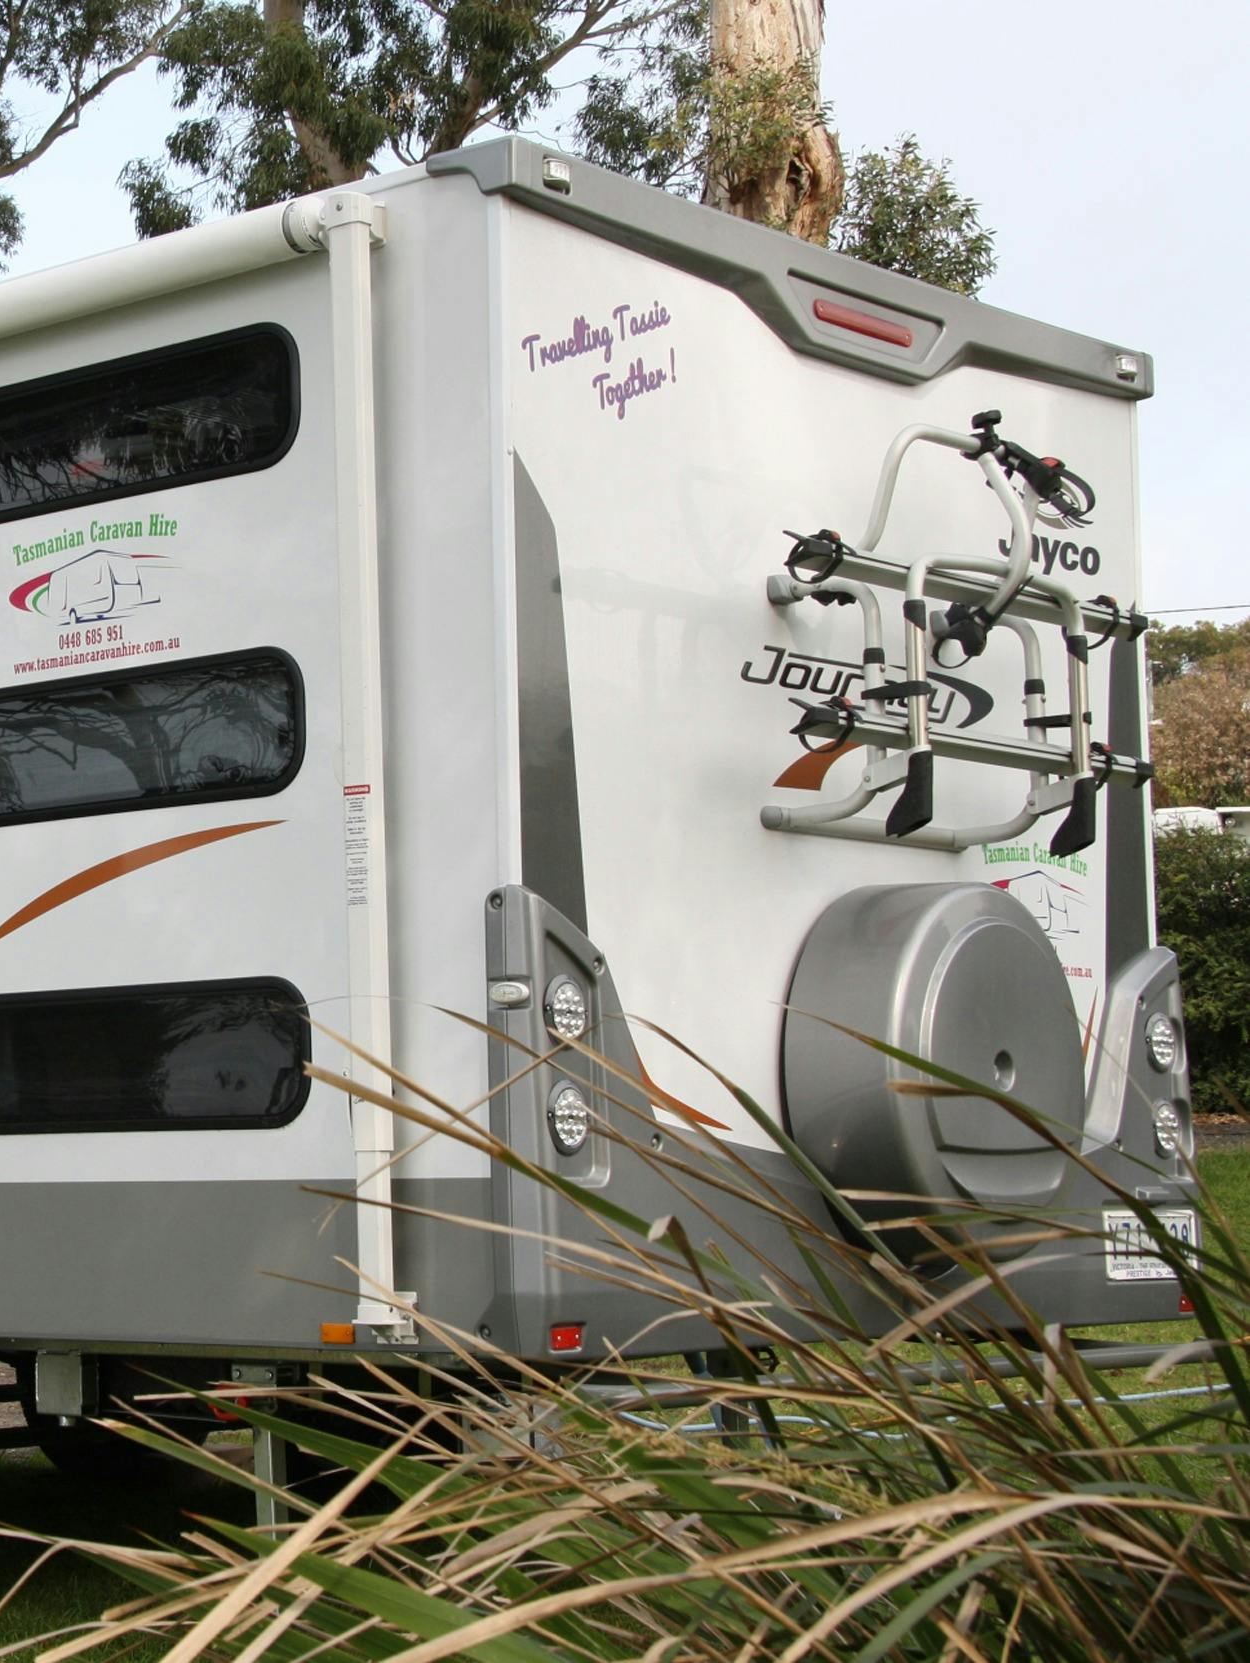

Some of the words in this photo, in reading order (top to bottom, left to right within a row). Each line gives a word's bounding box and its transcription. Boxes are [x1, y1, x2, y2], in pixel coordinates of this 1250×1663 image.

[521, 315, 614, 372] Travelling
[613, 300, 671, 341] Tassie
[592, 357, 667, 420] Together
[13, 528, 85, 566] Tasmanian
[90, 520, 143, 543] Caravan
[148, 513, 178, 537] Hire
[13, 636, 181, 675] www.tasmaniancaravanhire.com.au
[58, 631, 81, 650] 0448
[85, 628, 102, 645] 685
[106, 625, 124, 641] 951
[981, 841, 1030, 865] Tasmanian
